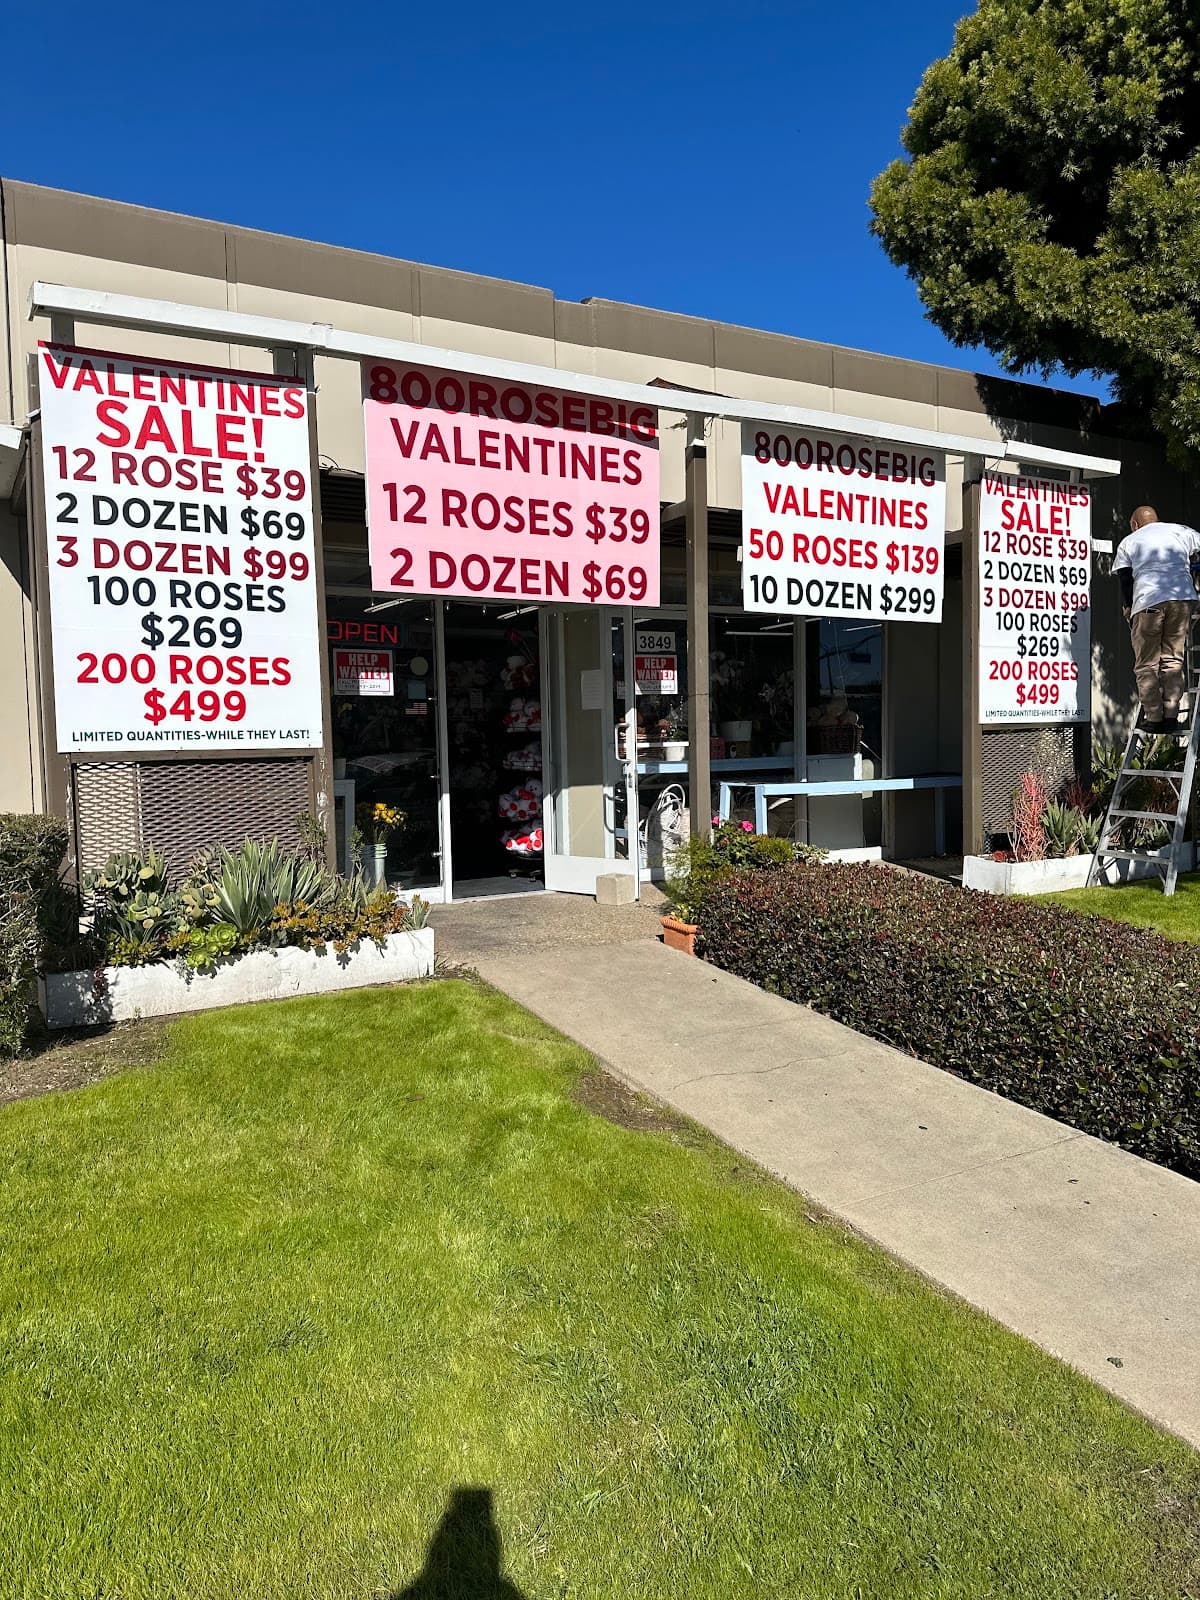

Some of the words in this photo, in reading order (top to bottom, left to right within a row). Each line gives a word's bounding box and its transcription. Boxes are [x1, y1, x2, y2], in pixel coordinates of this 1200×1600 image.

[43, 353, 305, 418] VALENTINES
[369, 365, 657, 442] 800ROSEBIG
[96, 399, 265, 463] SALE!
[390, 417, 642, 486] VALENTINES
[754, 431, 936, 487] 800ROSEBIG
[52, 446, 96, 482] 12
[111, 451, 224, 494] ROSE
[236, 463, 306, 501] $39
[985, 471, 1089, 507] VALENTINES
[56, 492, 78, 523] 2
[92, 495, 228, 535] DOZEN
[240, 505, 305, 541] $69
[383, 482, 427, 524] 12
[442, 488, 573, 538] ROSES
[585, 502, 650, 545] $39
[763, 482, 928, 530] VALENTINES
[1001, 499, 1071, 536] SALE!
[56, 535, 79, 567] 3
[93, 537, 230, 576] DOZEN
[243, 546, 309, 581] $99
[749, 528, 784, 561] 50
[793, 533, 878, 570] ROSES
[885, 541, 939, 575] $139
[983, 530, 1001, 553] 12
[1006, 532, 1053, 558] ROSE
[1058, 536, 1088, 561] $39
[390, 547, 414, 587] 2
[429, 550, 570, 596] DOZEN
[582, 560, 648, 602] $69
[984, 560, 993, 579] 2
[998, 561, 1055, 584] DOZEN
[1059, 564, 1087, 587] $69
[87, 575, 157, 607] 100
[169, 579, 286, 613] ROSES
[750, 574, 778, 604] 10
[787, 577, 872, 611] DOZEN
[880, 583, 935, 615] $299
[984, 587, 993, 607] 3
[999, 588, 1056, 610] DOZEN
[1061, 590, 1088, 613] $99
[141, 611, 242, 650] $269
[327, 620, 399, 644] OPEN
[996, 611, 1025, 631] 100
[1030, 613, 1078, 633] ROSES
[348, 653, 378, 666] HELP
[639, 636, 671, 649] 3849
[1017, 633, 1060, 659] $269
[76, 653, 156, 684] 200
[169, 655, 292, 686] ROSES
[340, 665, 388, 679] WANTED
[637, 669, 674, 680] WANTED
[644, 658, 667, 669] HELP
[989, 660, 1023, 680] 200
[1028, 661, 1078, 681] ROSES
[144, 687, 247, 726] $499
[1016, 682, 1059, 707] $499
[985, 710, 1007, 718] LIMITED
[72, 731, 123, 742] LIMITED
[127, 730, 244, 742] QUANTITIES-WHILE
[247, 730, 276, 740] THEY
[279, 729, 310, 740] LAST!
